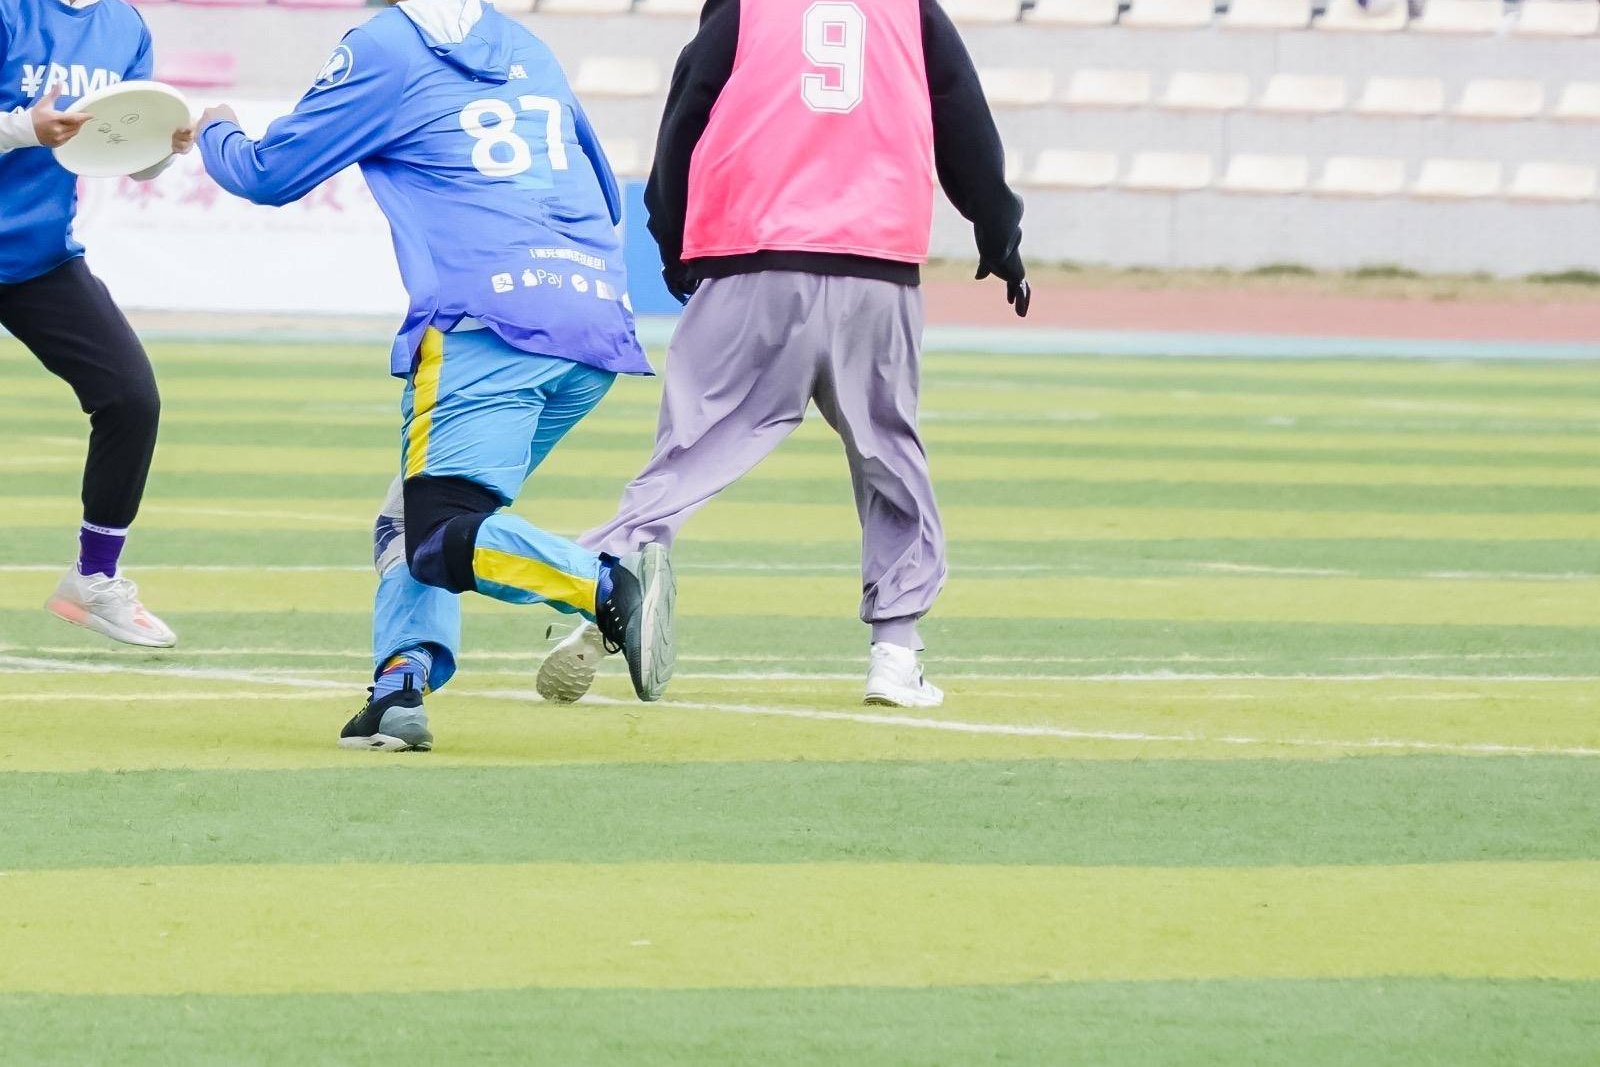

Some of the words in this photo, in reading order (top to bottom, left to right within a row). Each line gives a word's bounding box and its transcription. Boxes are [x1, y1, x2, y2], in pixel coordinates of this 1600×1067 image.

[800, 0, 867, 115] 9
[459, 94, 569, 177] 87
[536, 268, 563, 289] Pay
